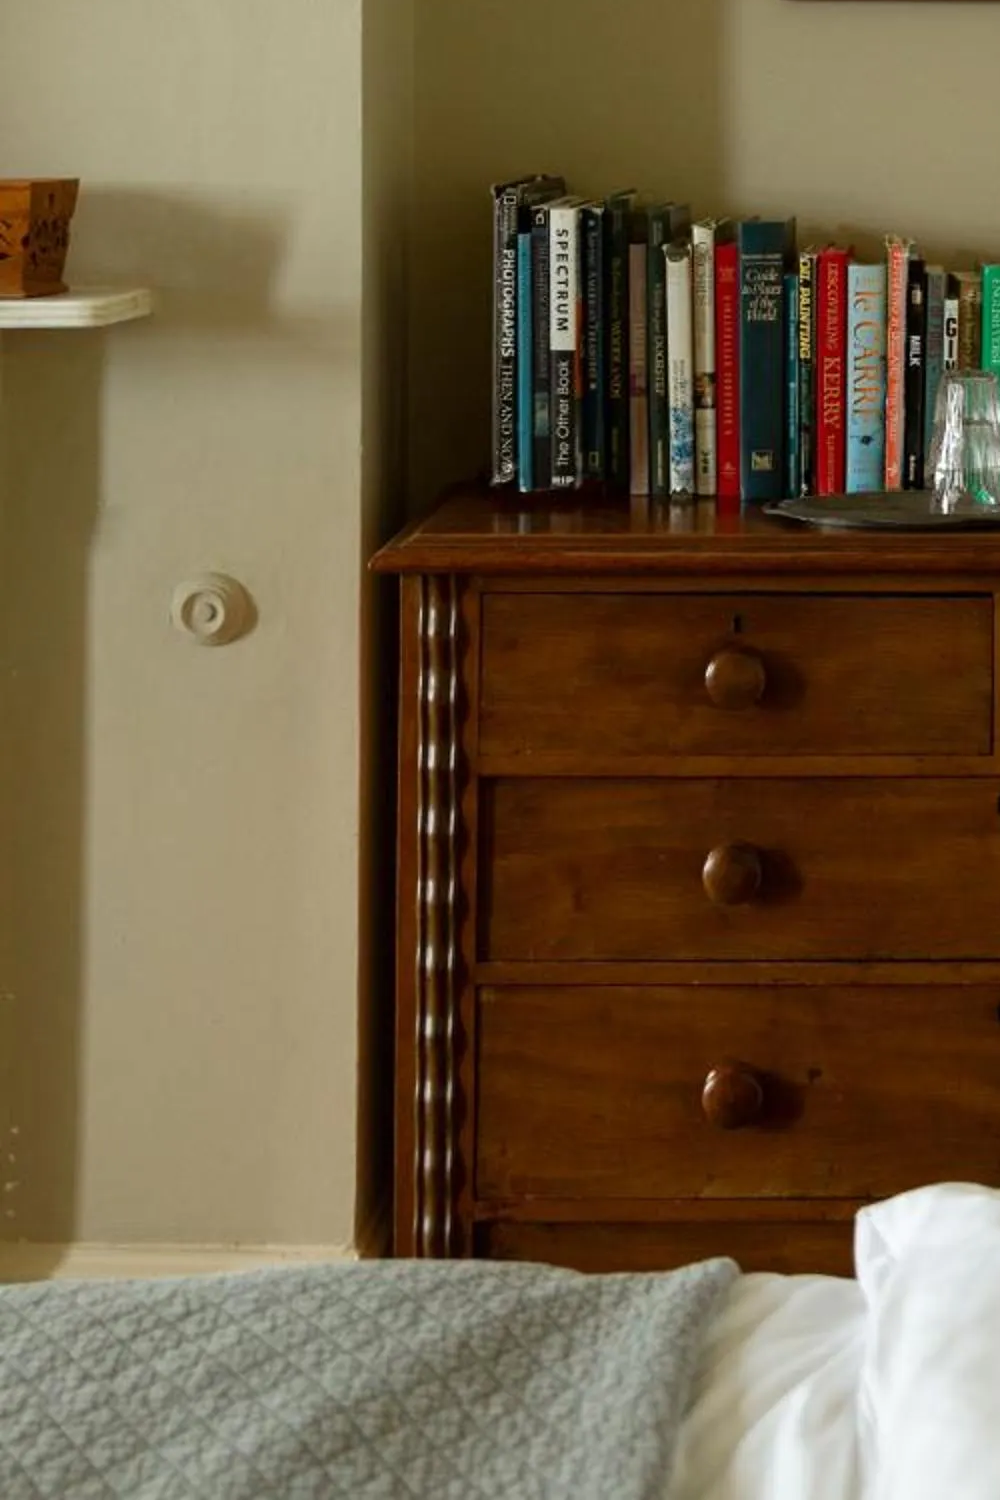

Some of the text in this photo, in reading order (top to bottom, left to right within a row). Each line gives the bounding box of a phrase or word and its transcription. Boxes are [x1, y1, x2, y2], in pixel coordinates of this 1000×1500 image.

[501, 249, 516, 357] PHOTOGRAPHS
[554, 229, 569, 332] SPECTRUM
[800, 260, 811, 283] OIL
[827, 262, 840, 350] DISCOVERING
[854, 291, 882, 311] le
[799, 287, 811, 359] PAINTING
[909, 335, 922, 367] MILK
[501, 363, 514, 400] THEN
[556, 359, 570, 467] The Other Book
[823, 356, 841, 429] KERRY
[500, 403, 513, 435] AND
